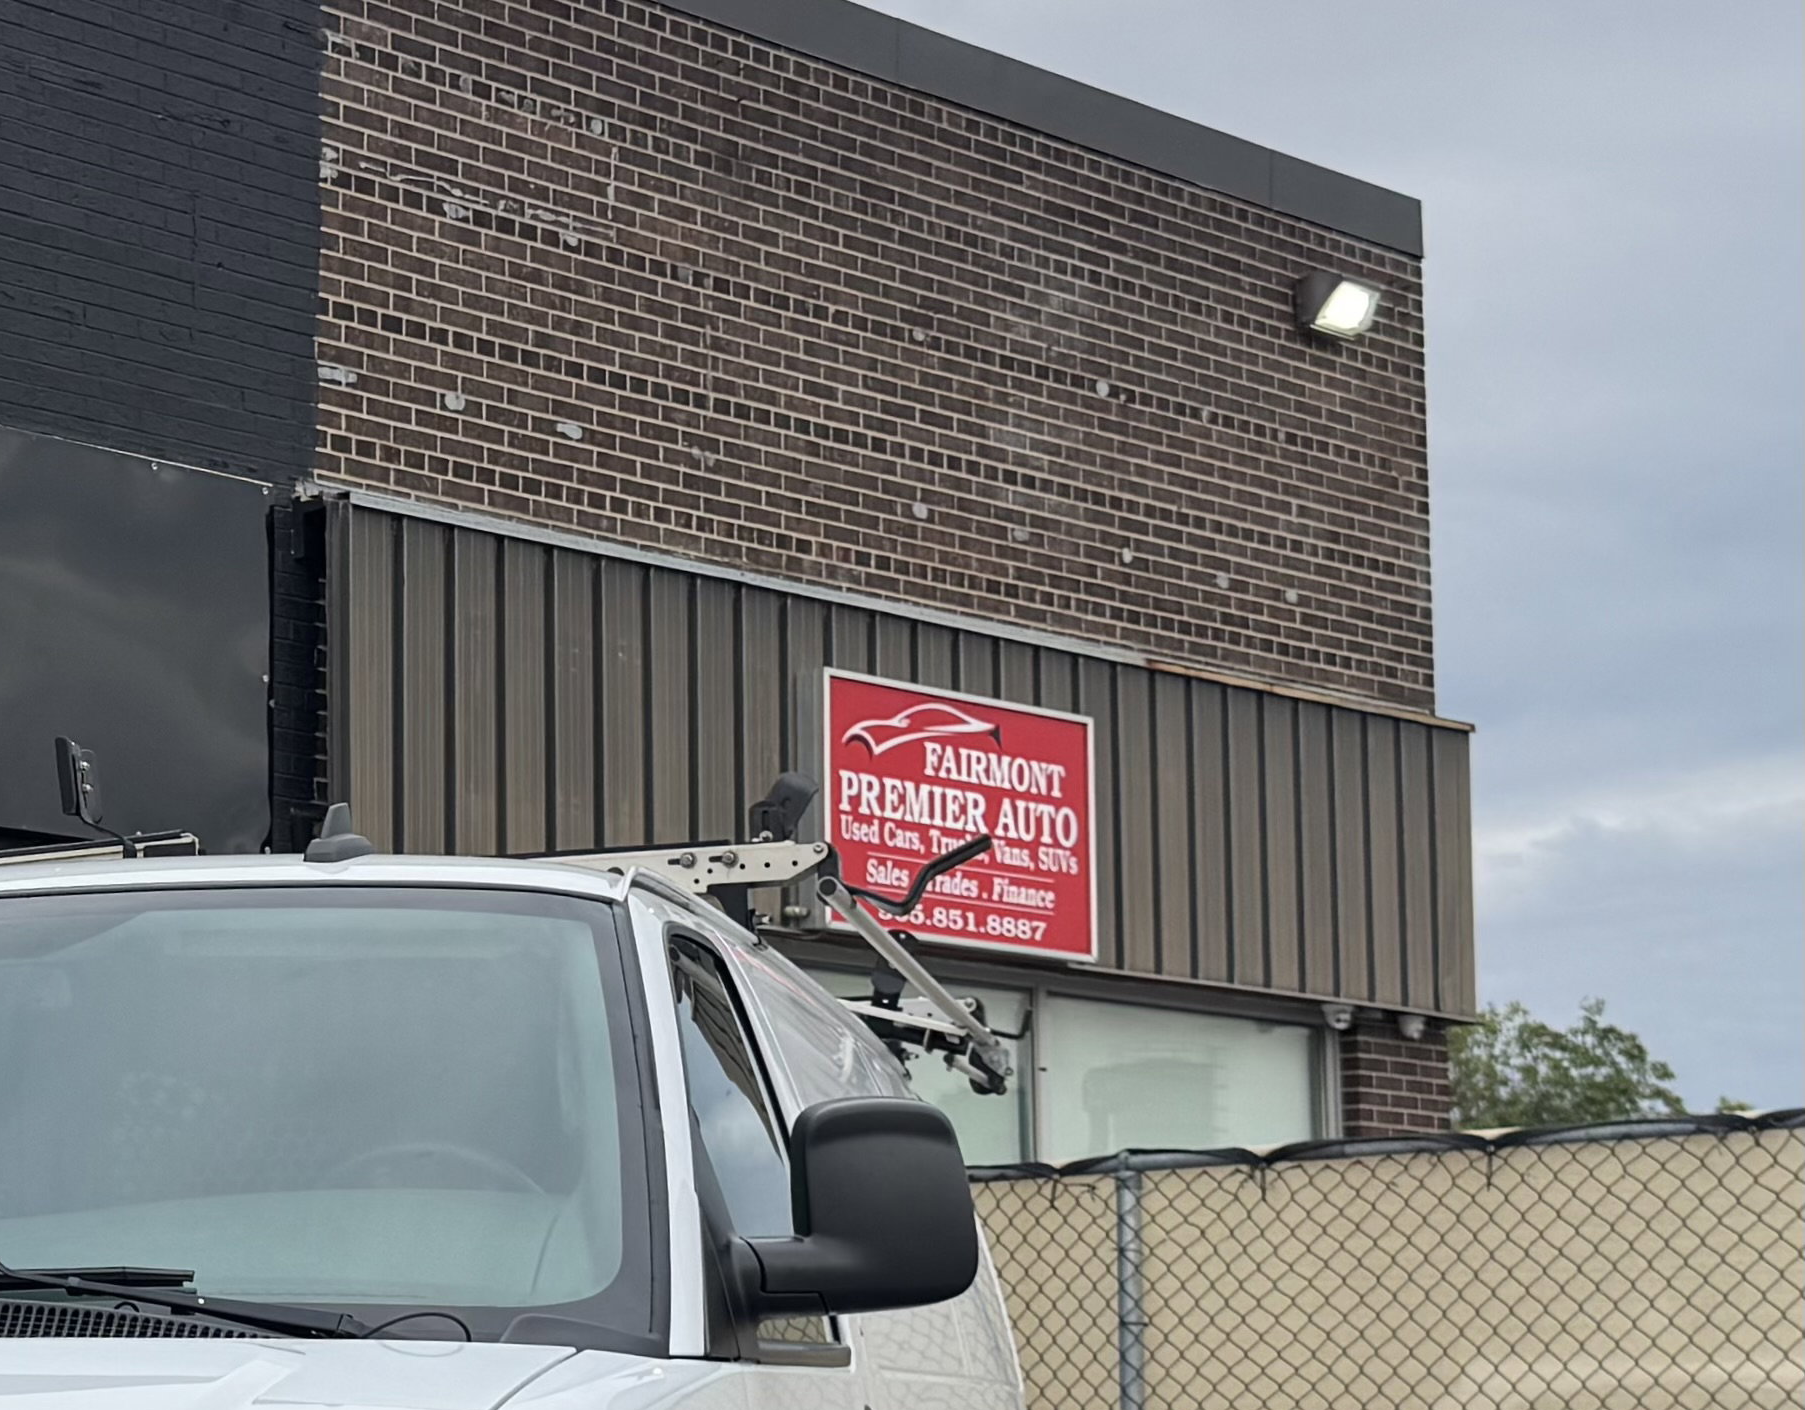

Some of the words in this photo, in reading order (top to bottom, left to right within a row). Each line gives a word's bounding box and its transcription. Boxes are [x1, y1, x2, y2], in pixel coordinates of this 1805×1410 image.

[923, 741, 1066, 798] FAIRMONT
[838, 769, 990, 834] PREMIER
[994, 798, 1078, 848] AUTO
[840, 814, 880, 844] Used
[884, 821, 925, 854] Cars,
[992, 838, 1035, 871] Vans,
[1038, 845, 1078, 875] SUVs
[866, 858, 910, 888] Sales
[991, 876, 1055, 909] Finance
